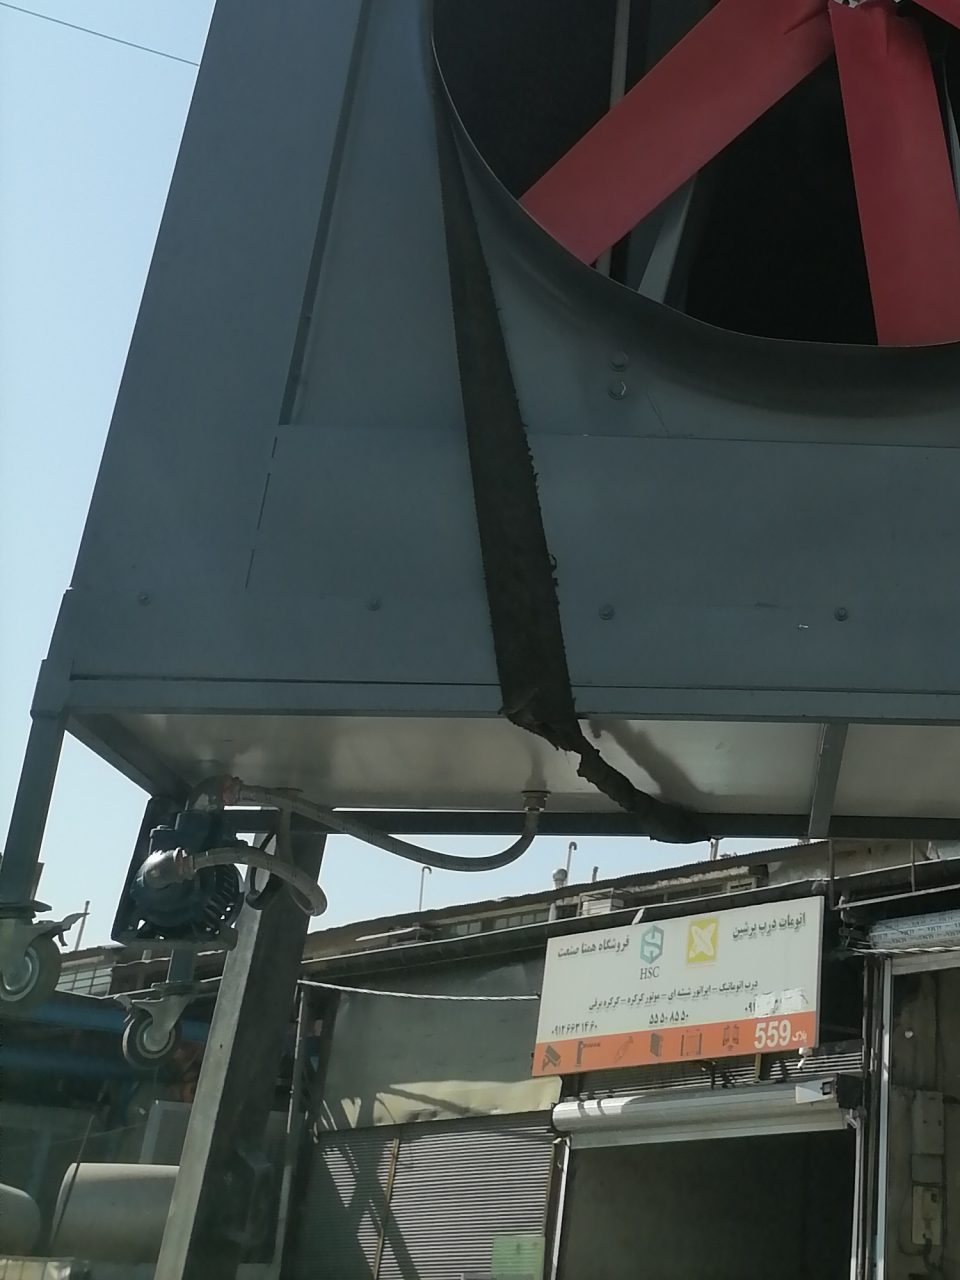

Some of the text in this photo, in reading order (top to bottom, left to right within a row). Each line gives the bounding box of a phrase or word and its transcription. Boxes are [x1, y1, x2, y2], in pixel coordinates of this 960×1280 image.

[598, 934, 630, 953] فروشگاه
[640, 966, 660, 980] HSC
[754, 1020, 791, 1049] 559
